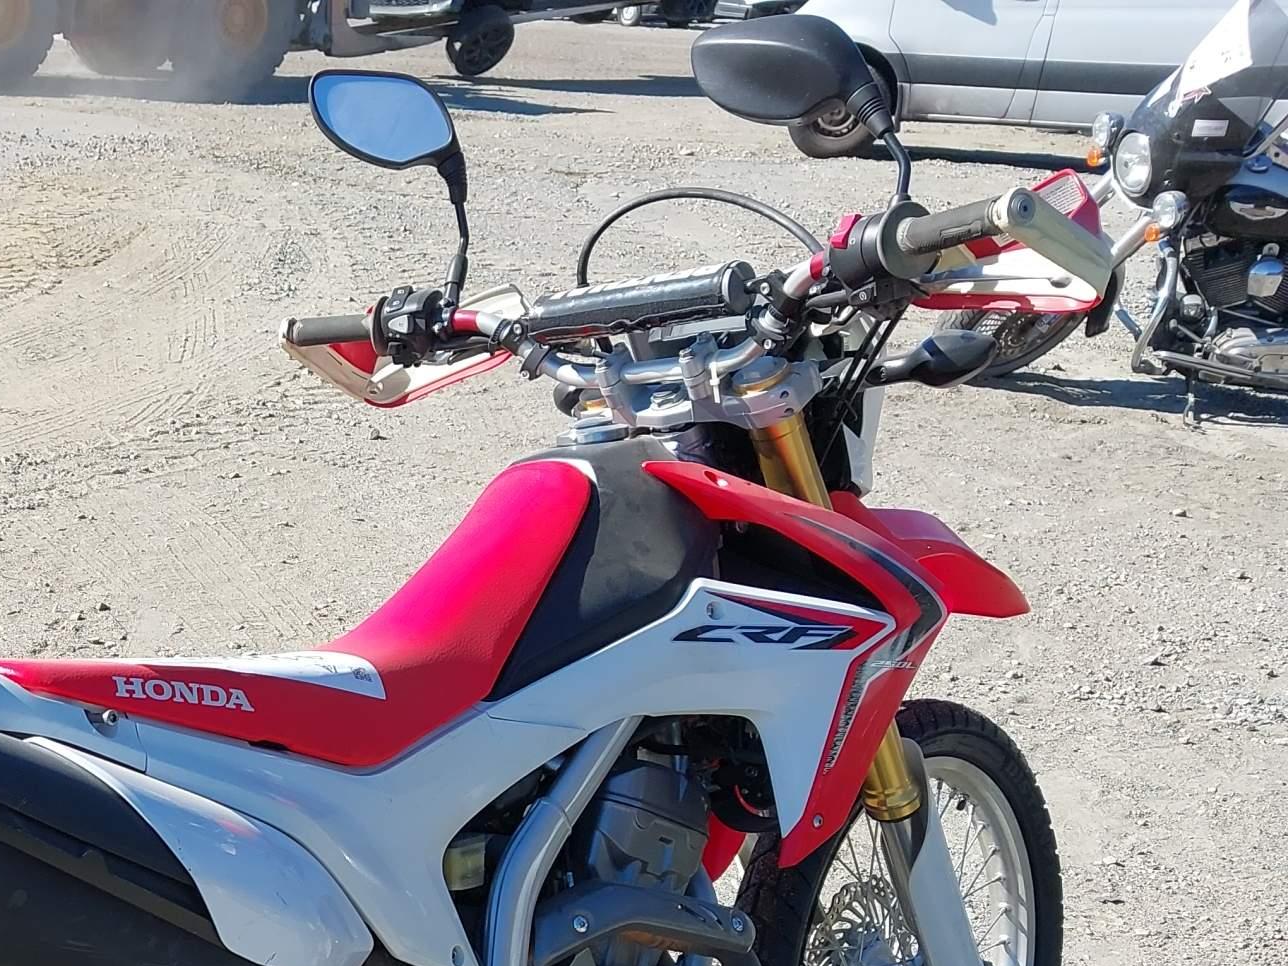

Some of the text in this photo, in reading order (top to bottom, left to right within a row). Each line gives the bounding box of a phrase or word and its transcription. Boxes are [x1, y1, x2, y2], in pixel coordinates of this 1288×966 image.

[672, 623, 858, 651] CRF
[870, 660, 917, 669] 250L
[112, 675, 255, 712] HONDA
